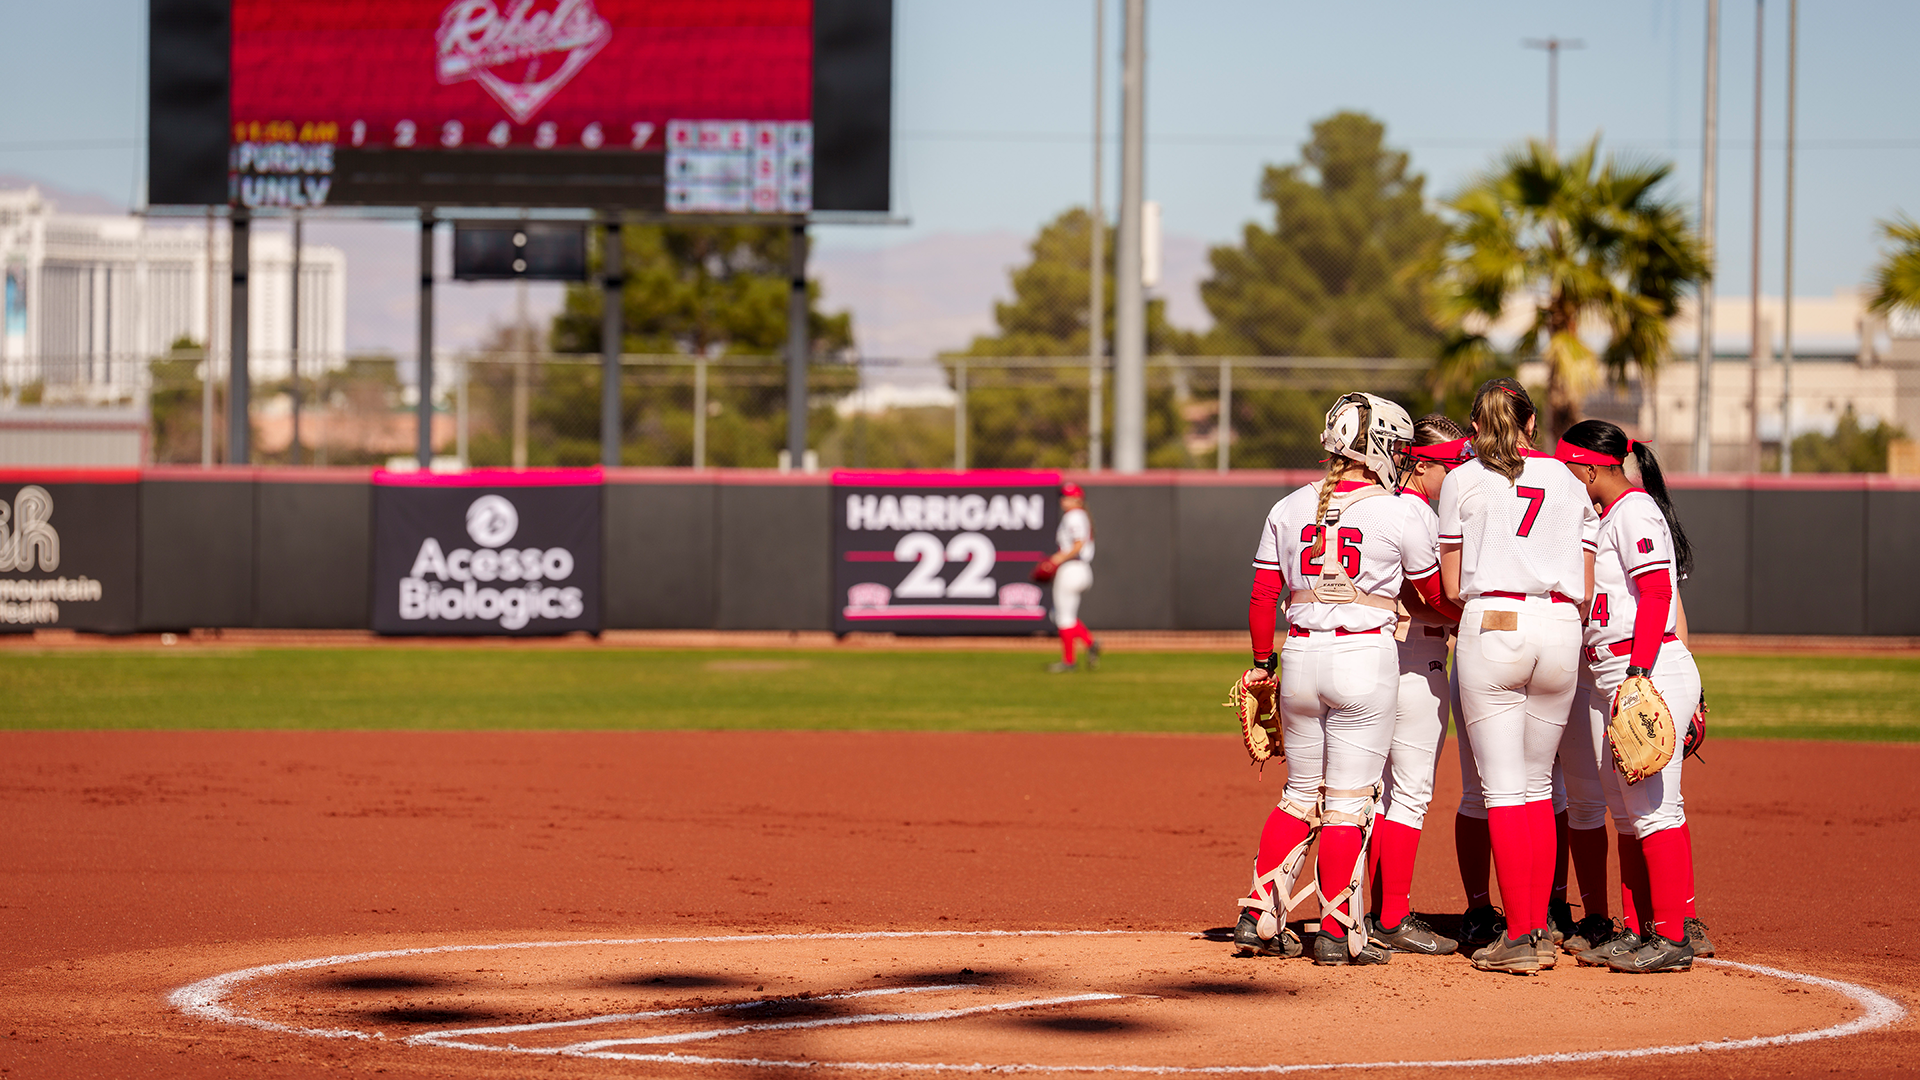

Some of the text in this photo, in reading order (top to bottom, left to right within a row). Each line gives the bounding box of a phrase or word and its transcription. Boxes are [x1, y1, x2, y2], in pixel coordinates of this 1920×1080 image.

[300, 120, 340, 144] AM
[350, 118, 655, 150] 1 2 3 4 5 6 7
[238, 141, 336, 174] PURDUE
[241, 175, 333, 208] UNLV
[846, 493, 1044, 531] HARRIGAN
[1516, 485, 1545, 537] 7
[410, 537, 575, 582] Acesso
[893, 531, 997, 598] 22
[1300, 523, 1363, 579] 26
[399, 577, 584, 630] Biologics
[1582, 593, 1610, 627] 4
